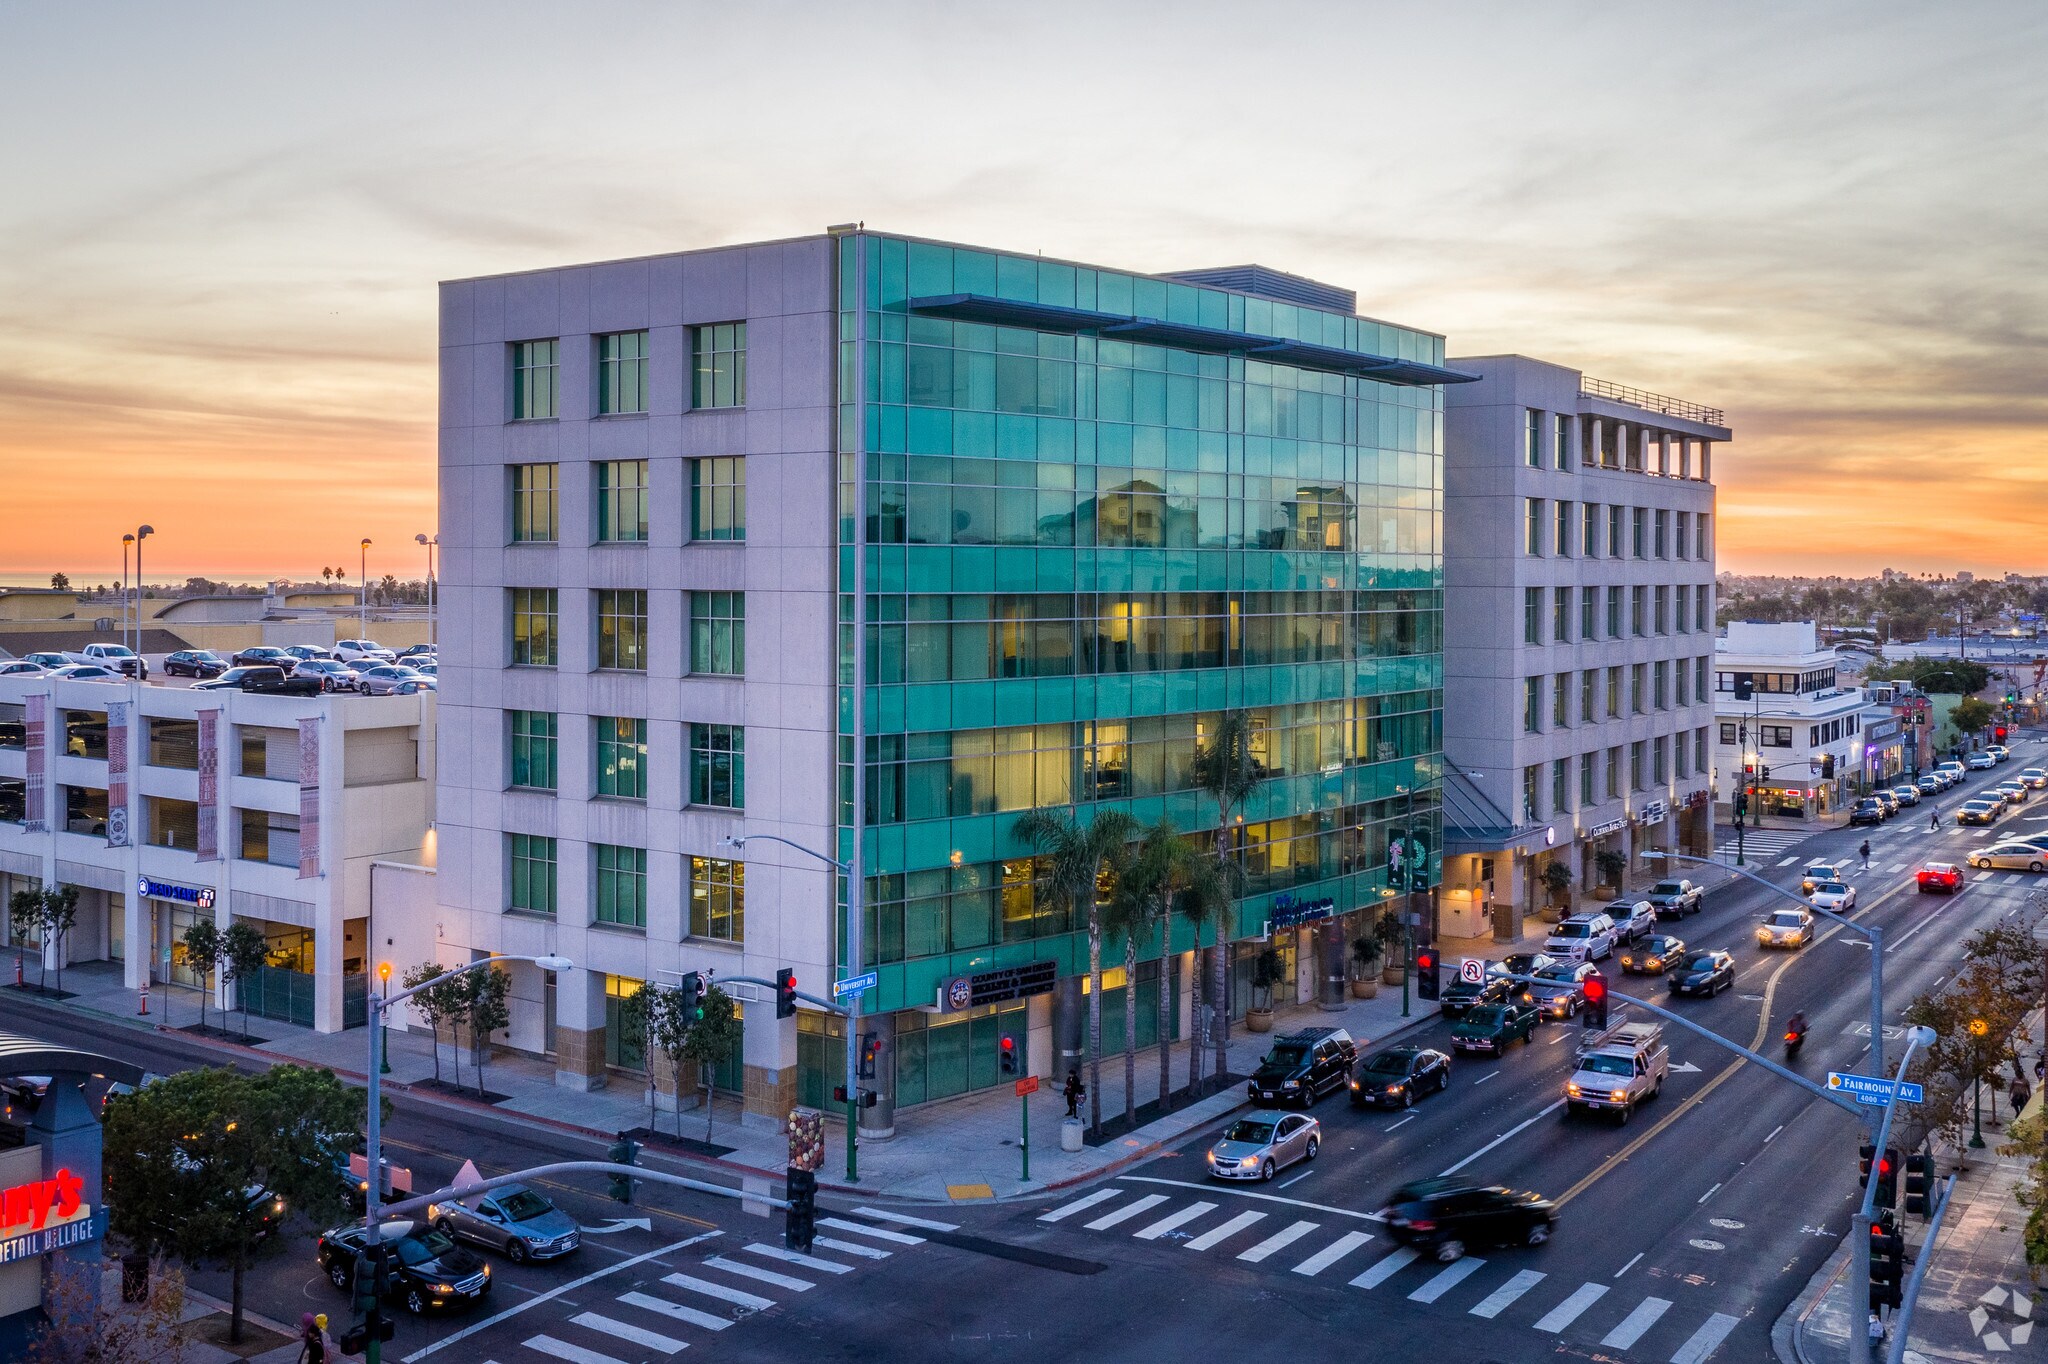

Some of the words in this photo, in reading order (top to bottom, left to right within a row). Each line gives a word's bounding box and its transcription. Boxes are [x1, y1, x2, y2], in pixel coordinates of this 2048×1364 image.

[148, 882, 172, 897] HEAD
[172, 886, 199, 901] START
[972, 970, 1005, 983] COUNTY
[1005, 968, 1016, 978] OF
[1016, 965, 1032, 975] SAN
[1032, 961, 1056, 972] DIEGO
[840, 979, 866, 992] UNIVERSITY
[1860, 1094, 1878, 1103] 4000
[1900, 1086, 1916, 1098] AV.
[0, 1168, 83, 1230] ny's
